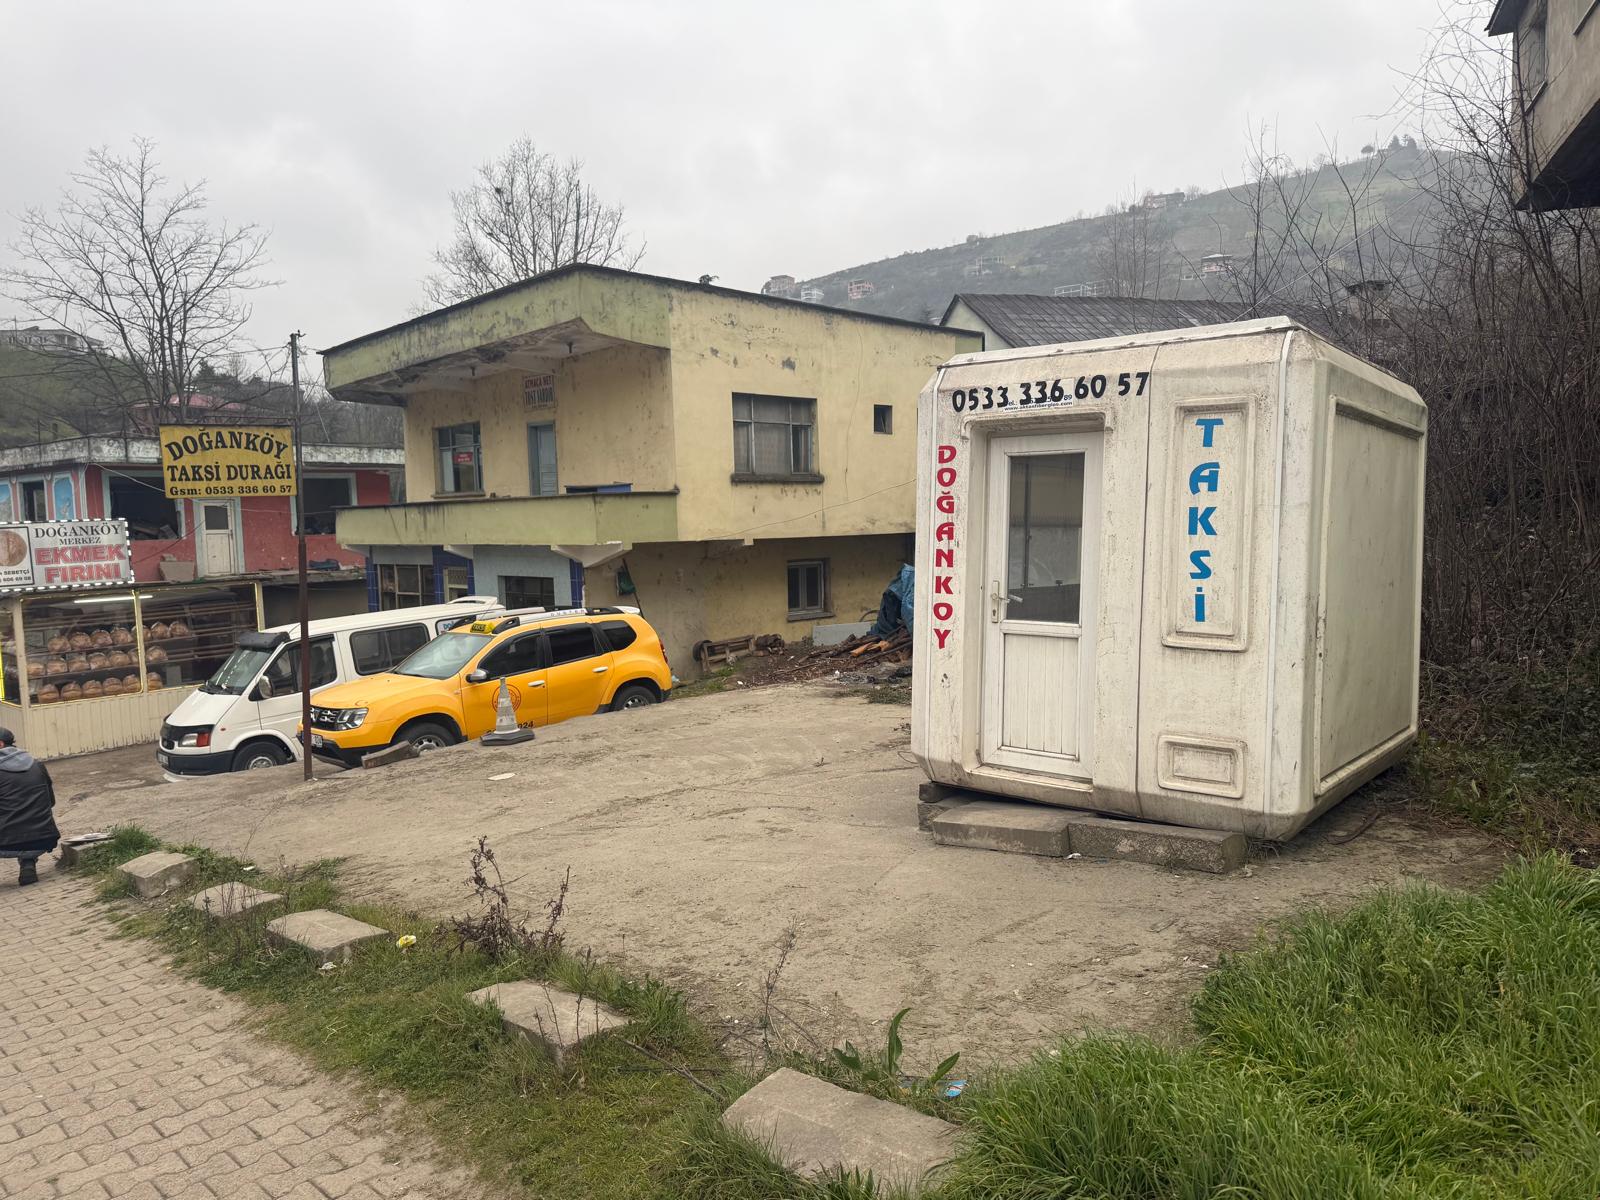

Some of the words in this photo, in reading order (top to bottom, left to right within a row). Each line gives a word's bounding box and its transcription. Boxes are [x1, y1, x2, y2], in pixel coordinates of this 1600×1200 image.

[952, 386, 1009, 412] 0533
[1019, 379, 1065, 405] 336
[1074, 374, 1107, 399] 60
[1118, 372, 1149, 396] 57
[165, 427, 288, 461] DOĞANKÖY
[167, 461, 221, 481] TAKSİ
[226, 461, 292, 481] DURAĞI
[170, 486, 202, 496] Gsm:
[205, 485, 234, 495] 0533
[238, 485, 259, 494] 336
[262, 485, 276, 494] 60
[280, 485, 292, 493] 57
[35, 523, 120, 538] DOĞANKÖY
[1187, 418, 1224, 622] TAKSİ
[59, 537, 102, 546] MERKEZ
[933, 445, 957, 649] DOĞANKOY
[35, 544, 126, 565] EKMEK
[45, 563, 121, 584] FIRINI
